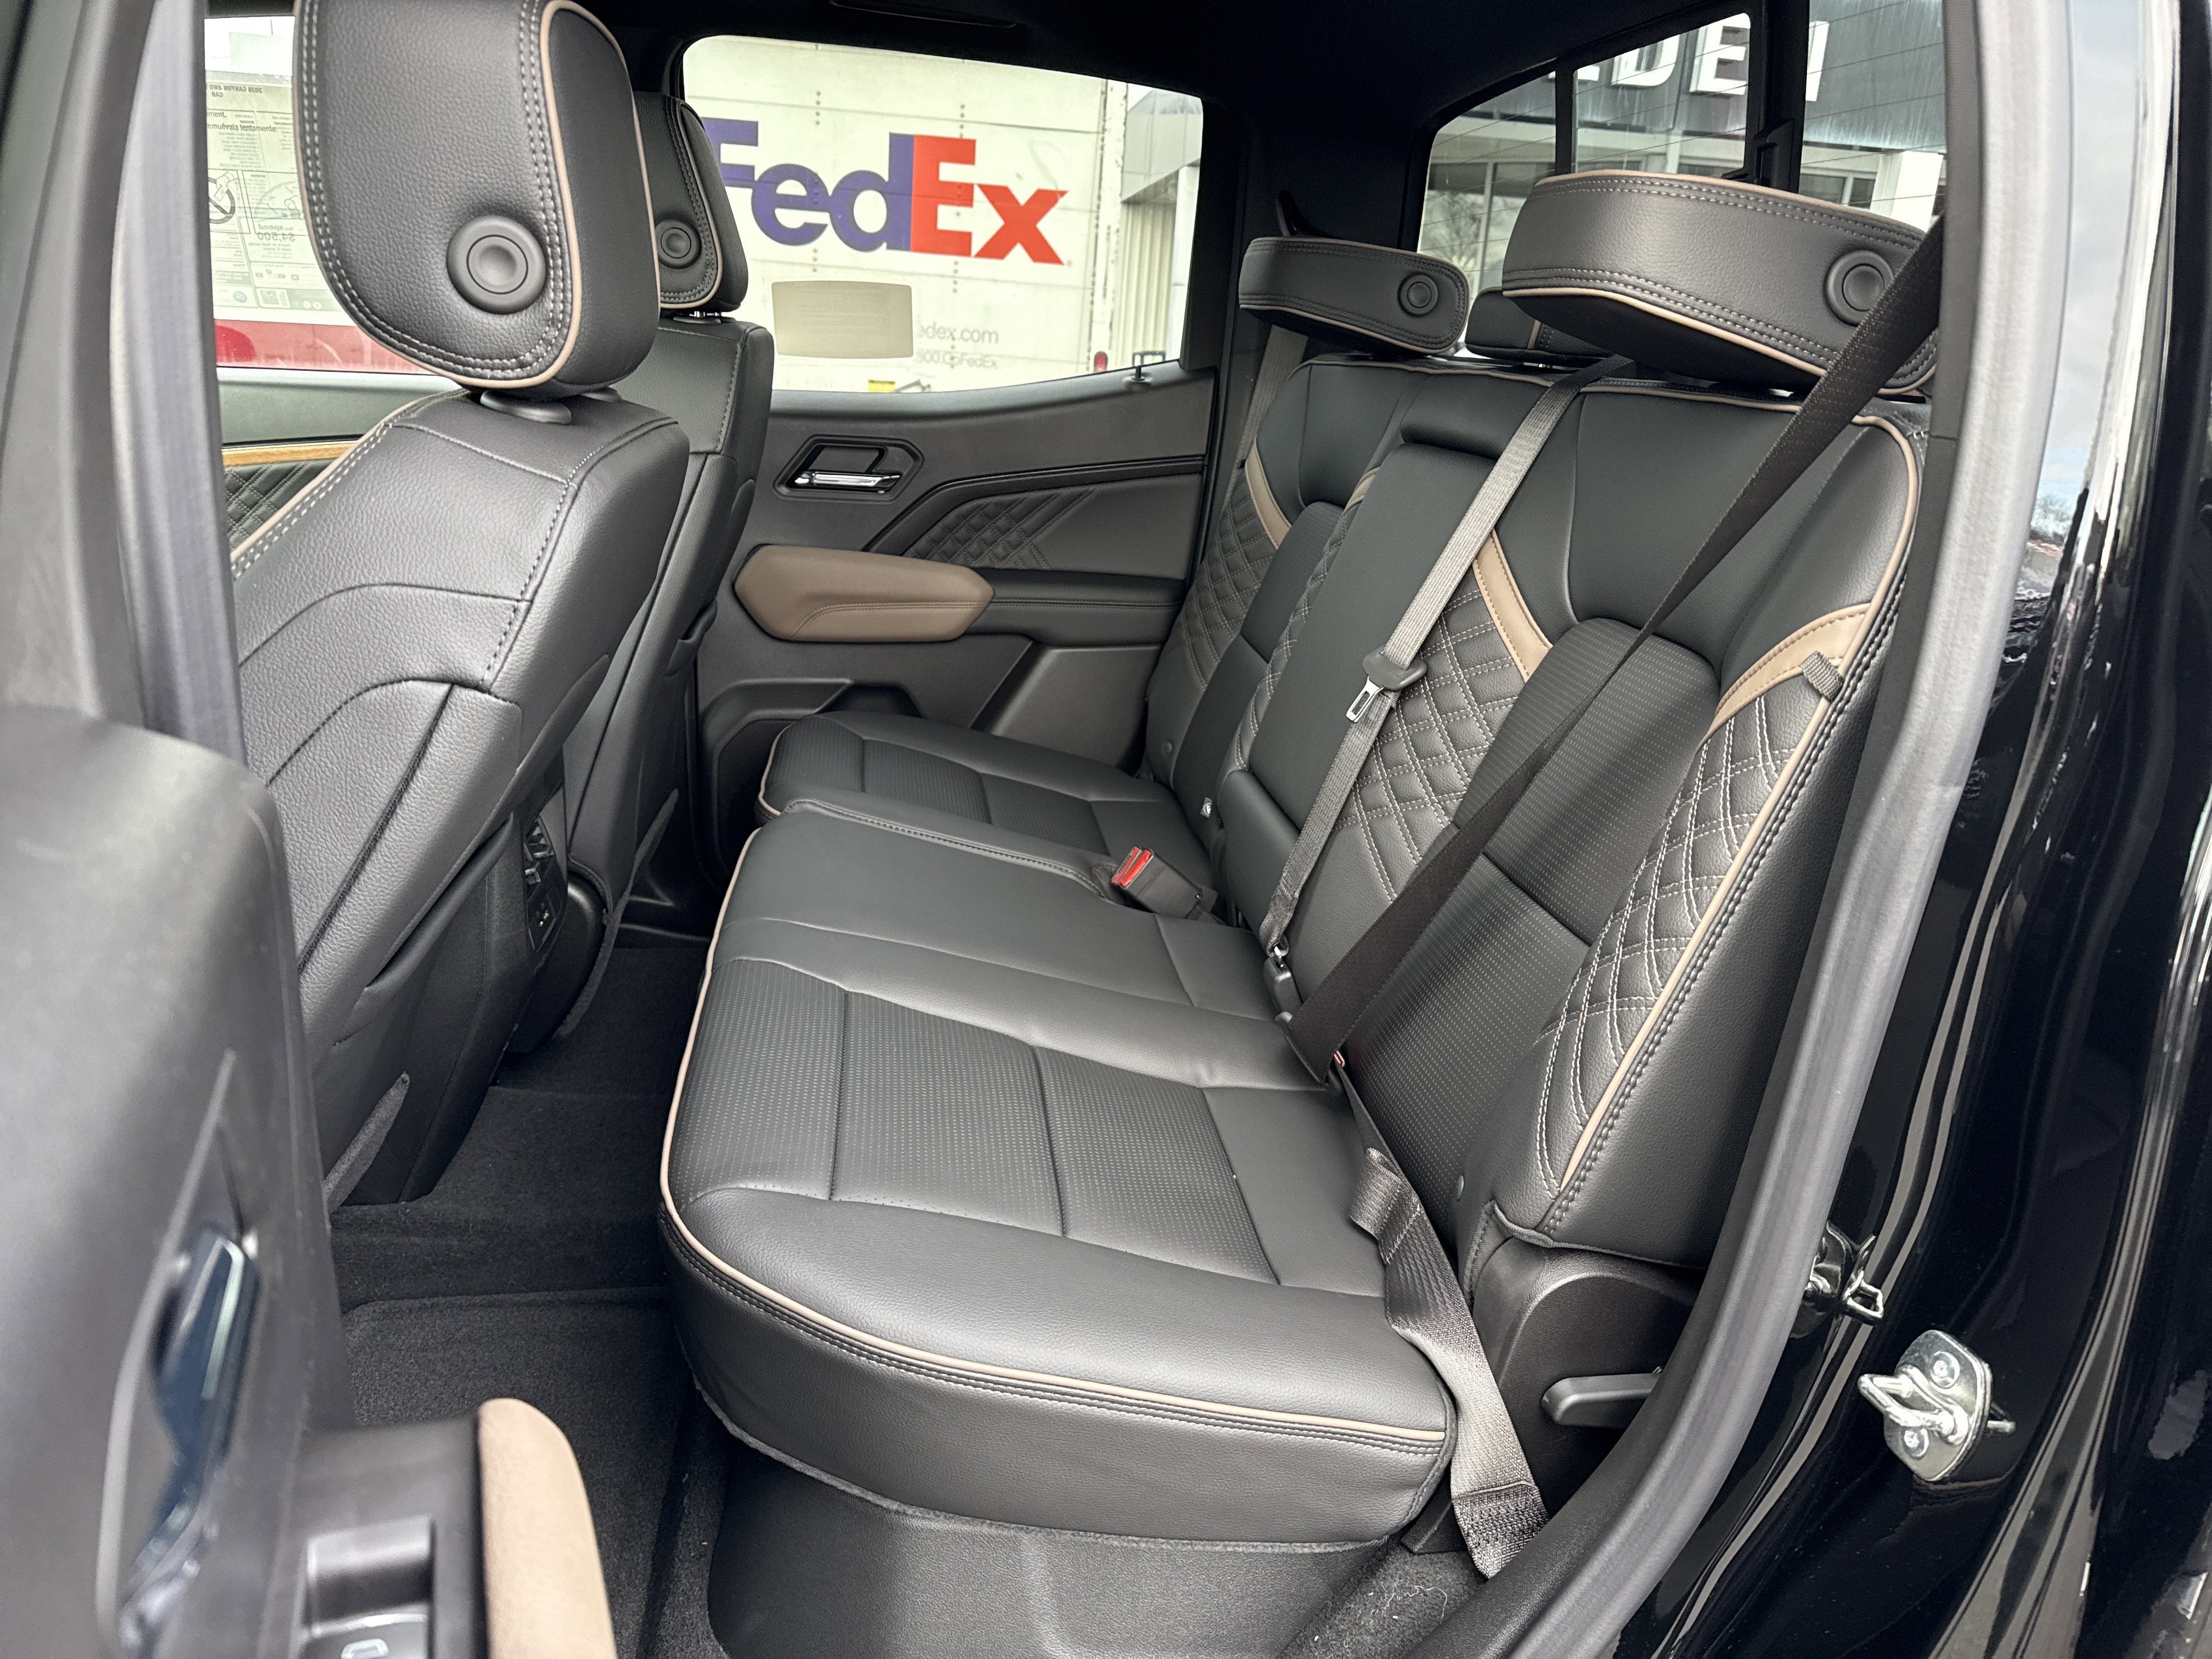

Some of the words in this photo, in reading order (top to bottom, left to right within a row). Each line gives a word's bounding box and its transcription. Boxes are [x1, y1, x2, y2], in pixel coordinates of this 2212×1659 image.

[208, 122, 239, 131] emuévala
[699, 116, 1068, 266] FedEx
[916, 320, 999, 343] edex.com
